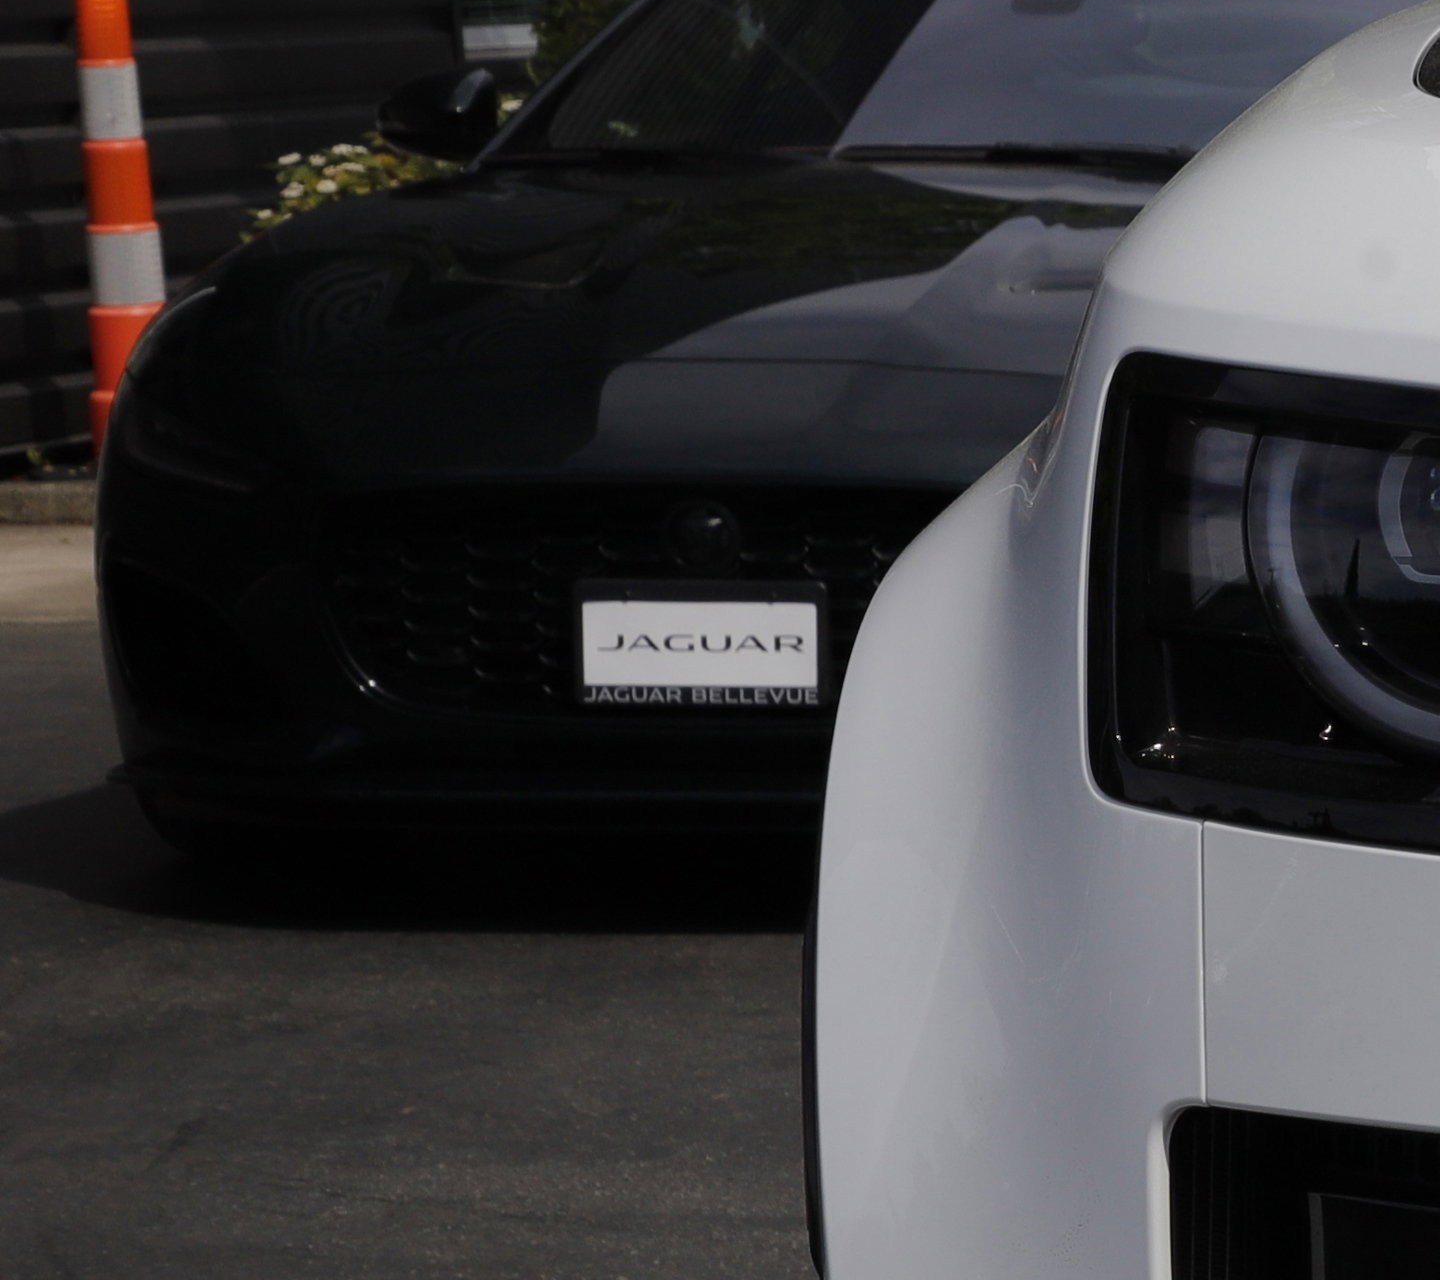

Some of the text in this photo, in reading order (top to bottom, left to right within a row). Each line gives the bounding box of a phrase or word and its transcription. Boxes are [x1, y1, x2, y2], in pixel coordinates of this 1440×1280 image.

[596, 634, 804, 653] JAGUAR
[584, 686, 818, 704] JAGUAR BELLEVUE
